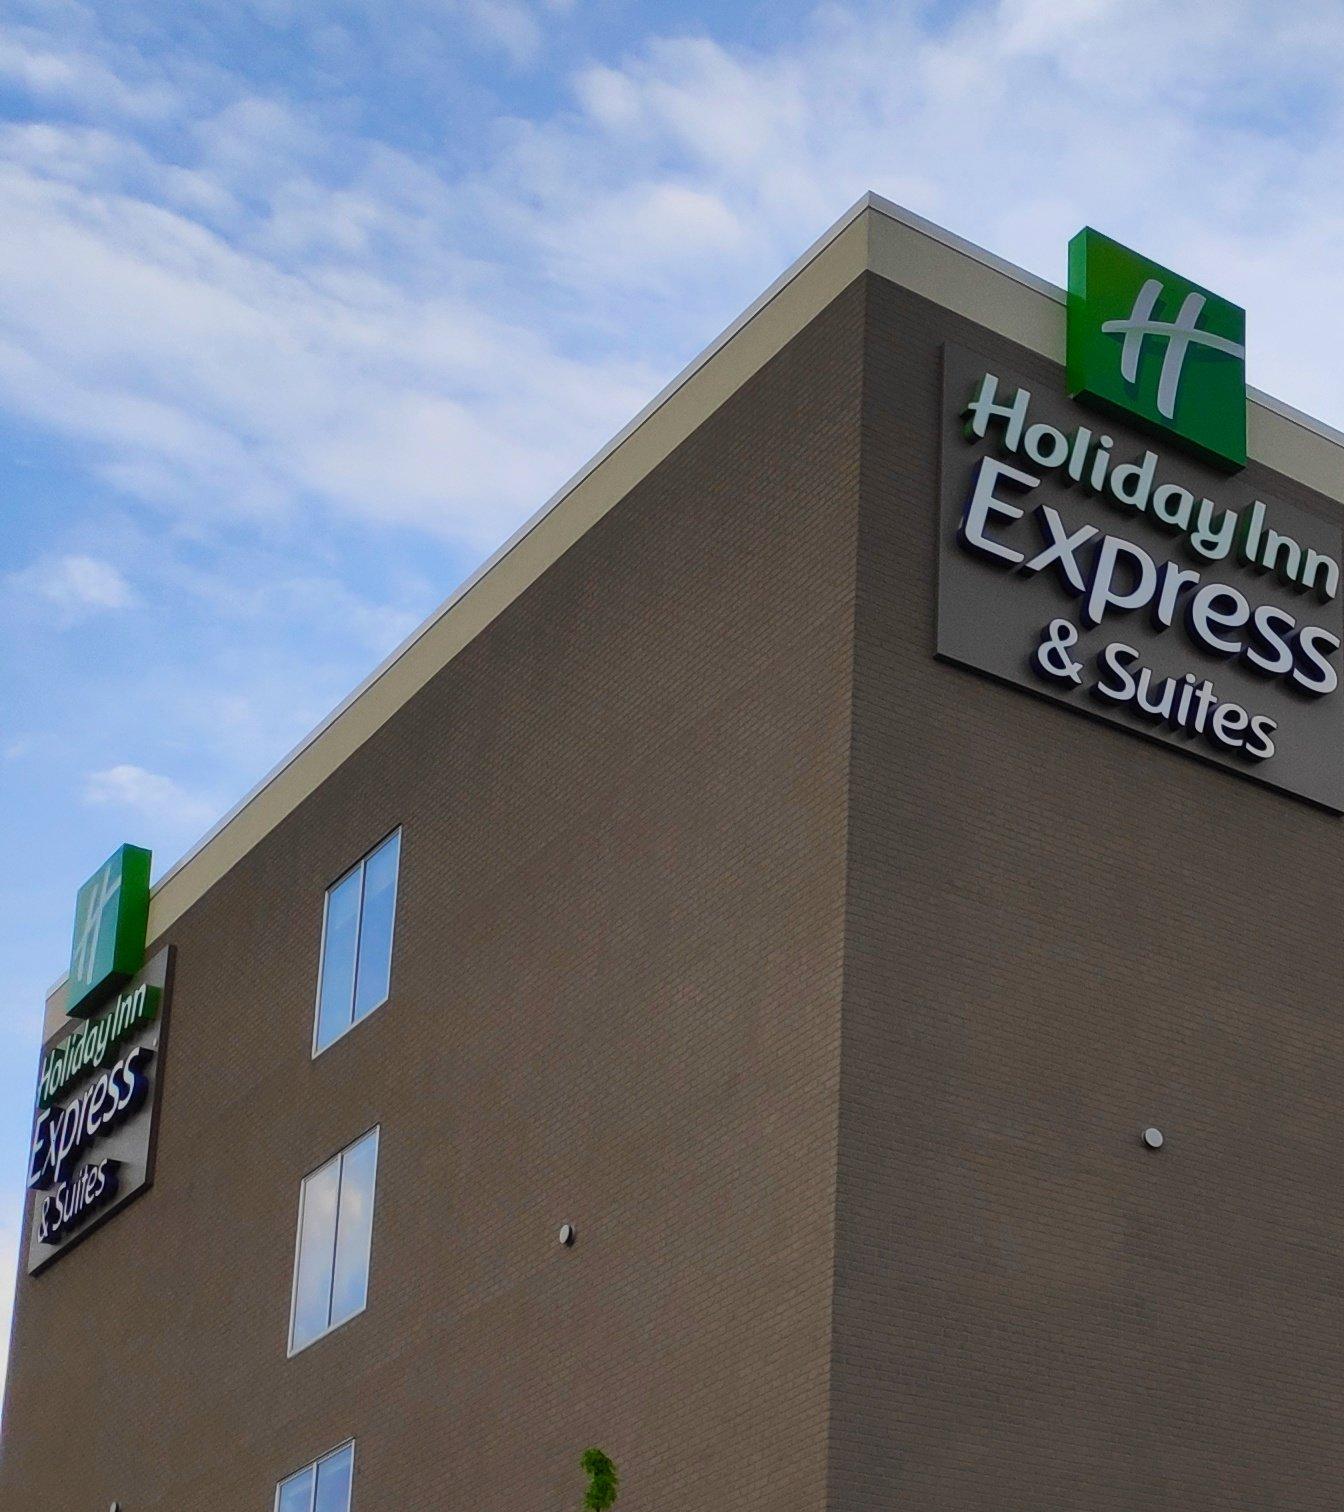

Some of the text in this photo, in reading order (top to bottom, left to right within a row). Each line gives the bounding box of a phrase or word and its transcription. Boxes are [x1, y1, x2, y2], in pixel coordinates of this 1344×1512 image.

[967, 372, 1340, 600] Holiday Inn
[963, 455, 1342, 695] Express
[1036, 617, 1278, 760] & Suites
[39, 983, 147, 1102] Holiday Inn
[26, 1046, 141, 1189] Express
[37, 1158, 109, 1244] & Suites
